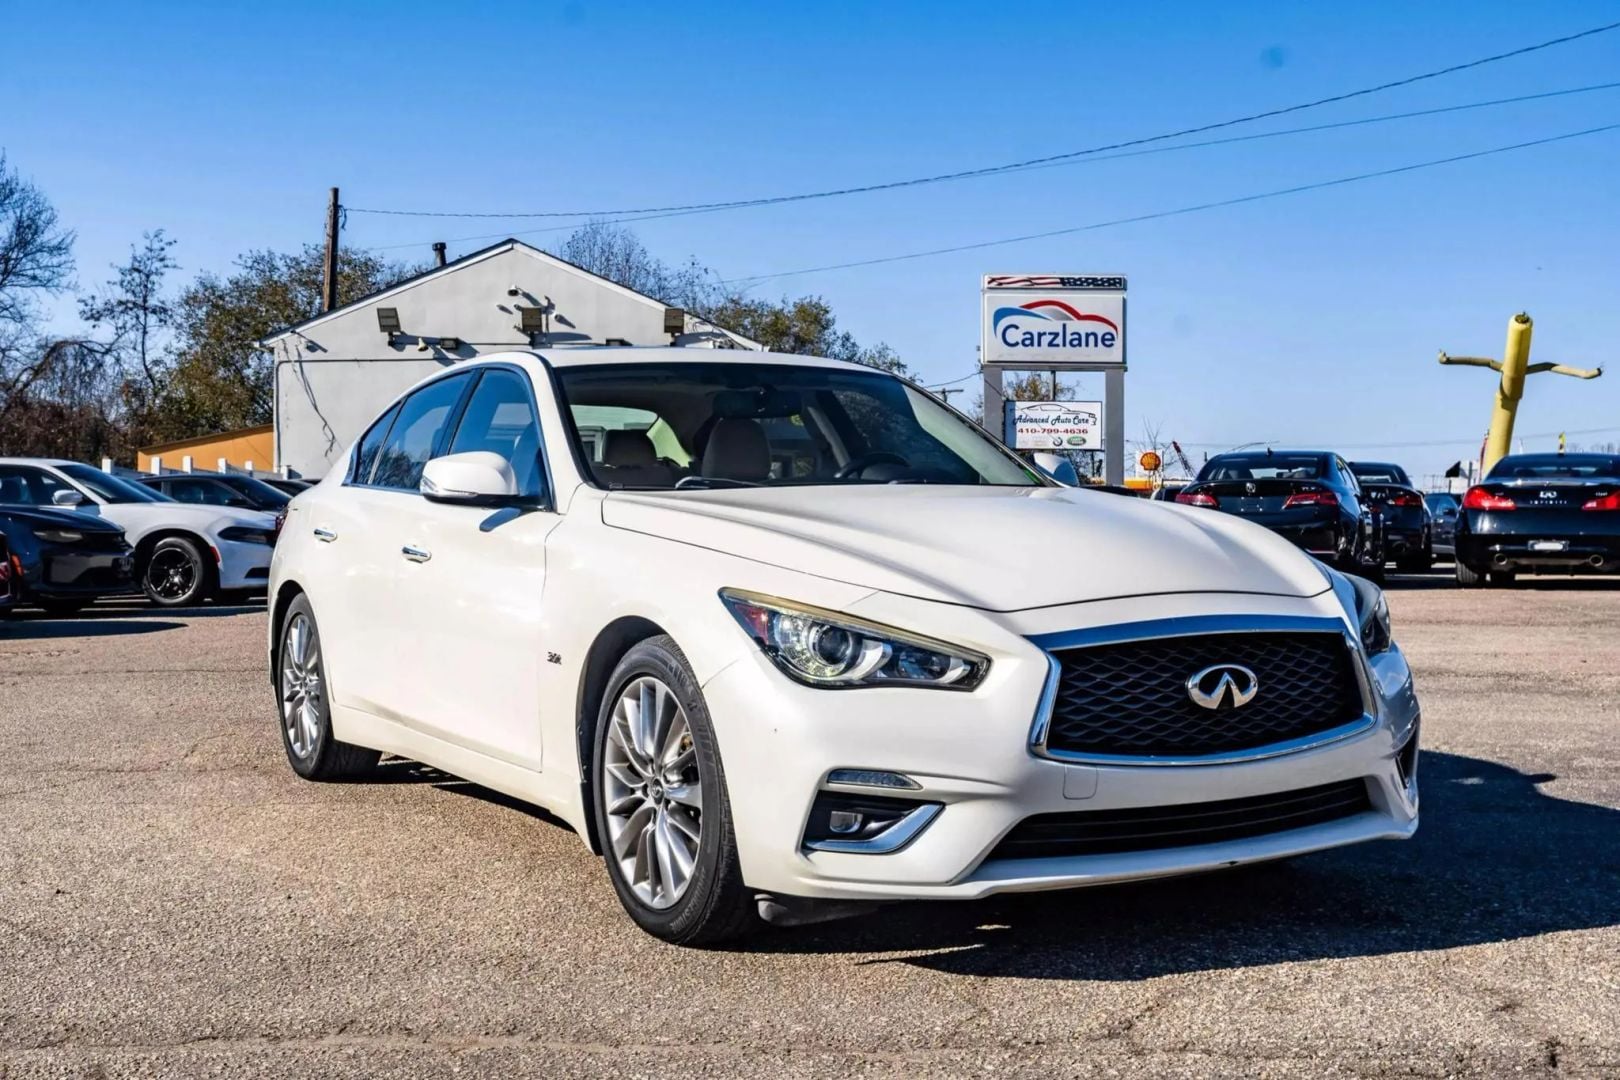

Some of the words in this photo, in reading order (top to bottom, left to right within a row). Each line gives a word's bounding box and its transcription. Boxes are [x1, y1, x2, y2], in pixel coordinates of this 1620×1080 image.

[1001, 323, 1116, 348] Carzlane
[1013, 415, 1050, 425] Advanced
[1051, 415, 1071, 425] Auto
[1072, 415, 1090, 425] Care
